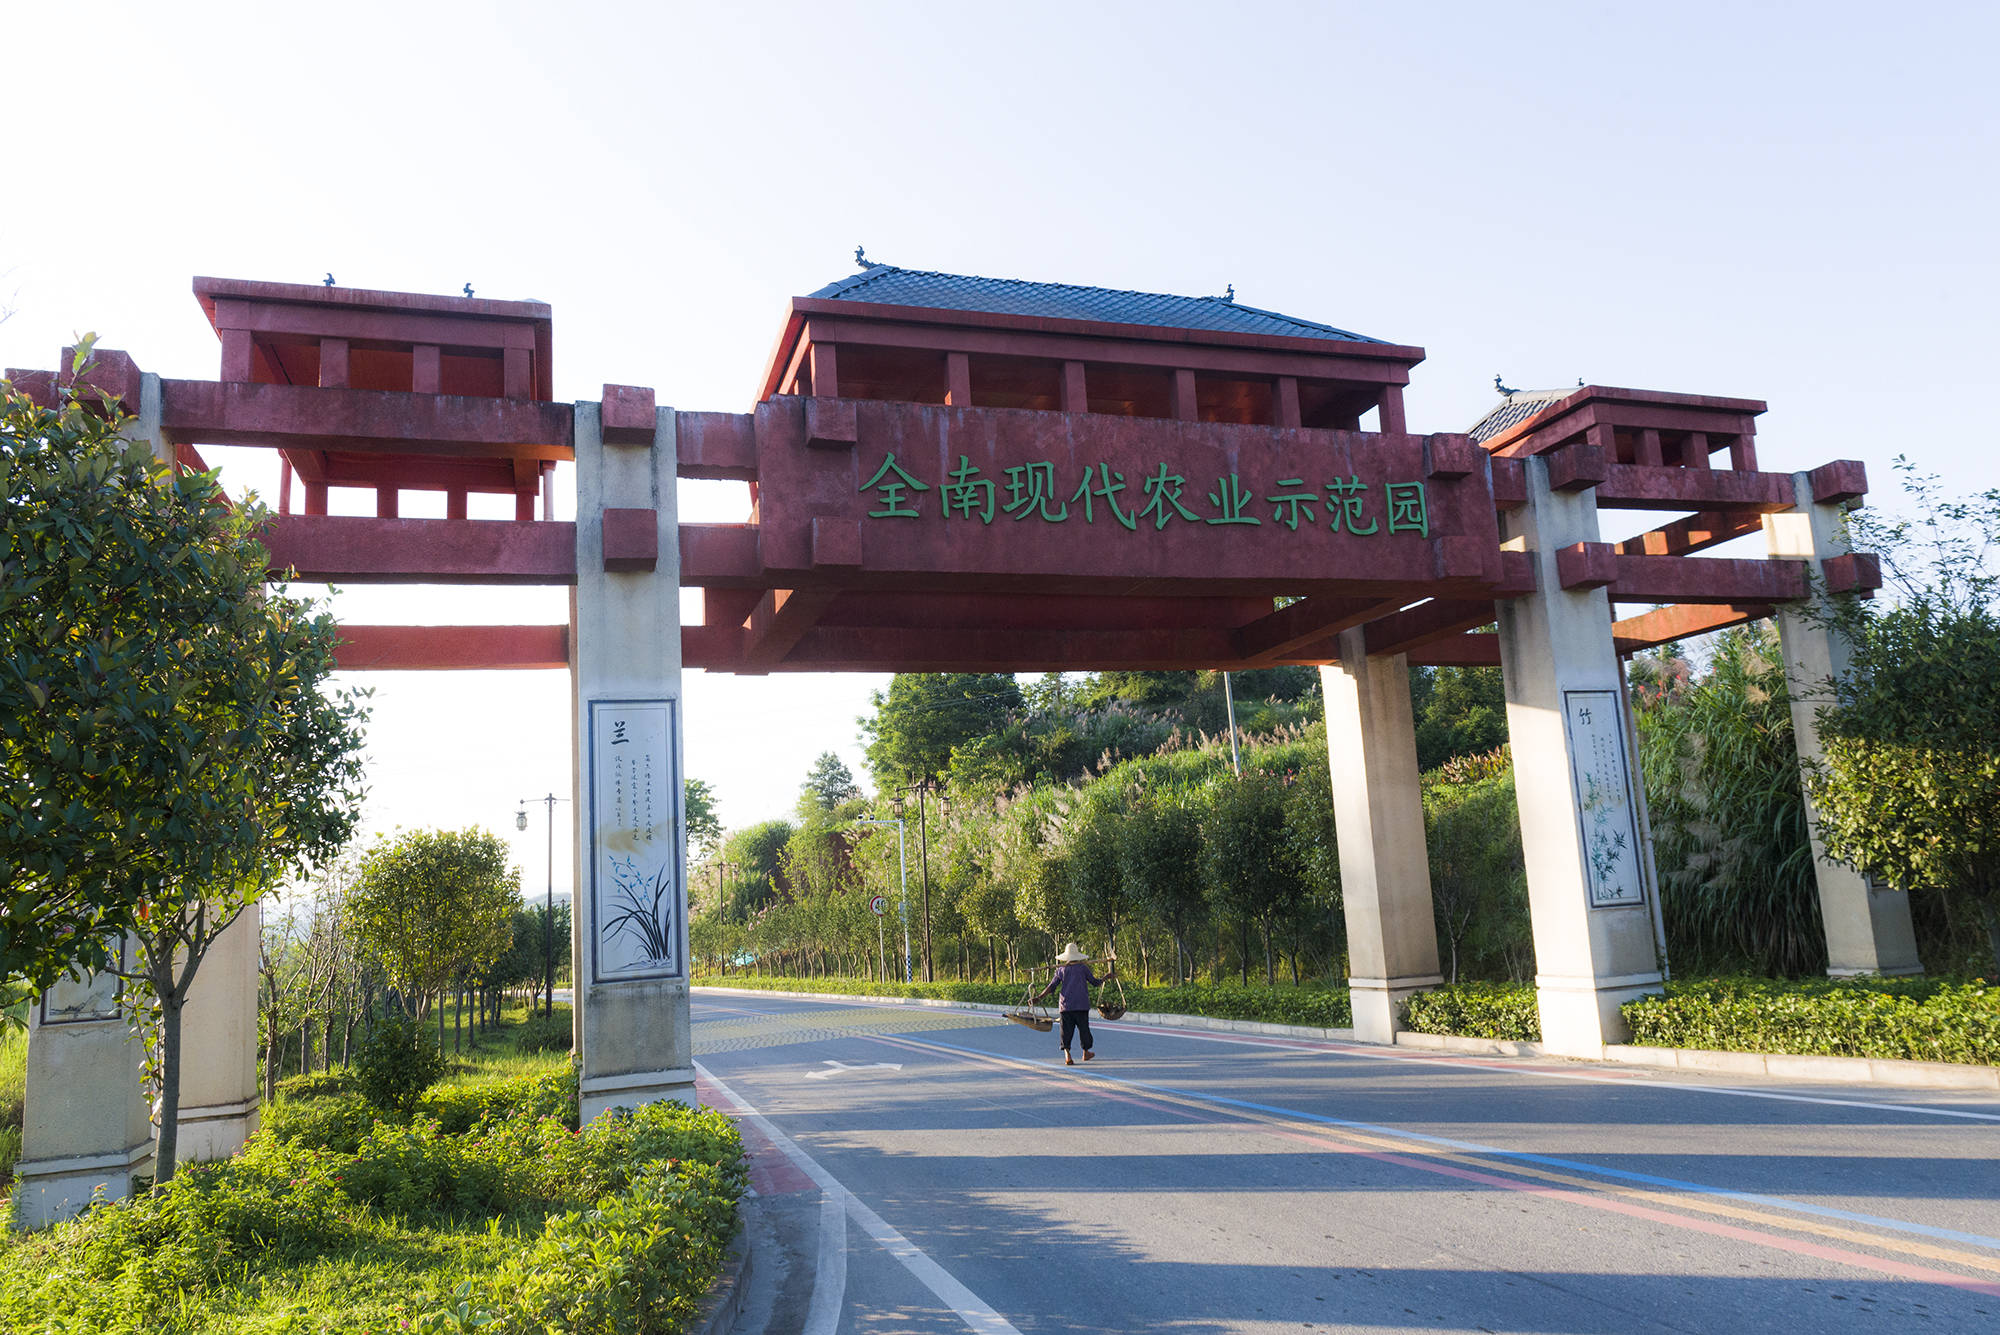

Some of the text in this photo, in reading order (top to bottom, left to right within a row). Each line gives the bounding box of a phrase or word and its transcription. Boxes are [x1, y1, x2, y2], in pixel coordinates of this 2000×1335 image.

[859, 452, 1431, 539] 全南现代农业示范园
[1579, 708, 1592, 725] 竹
[611, 720, 629, 745] 兰
